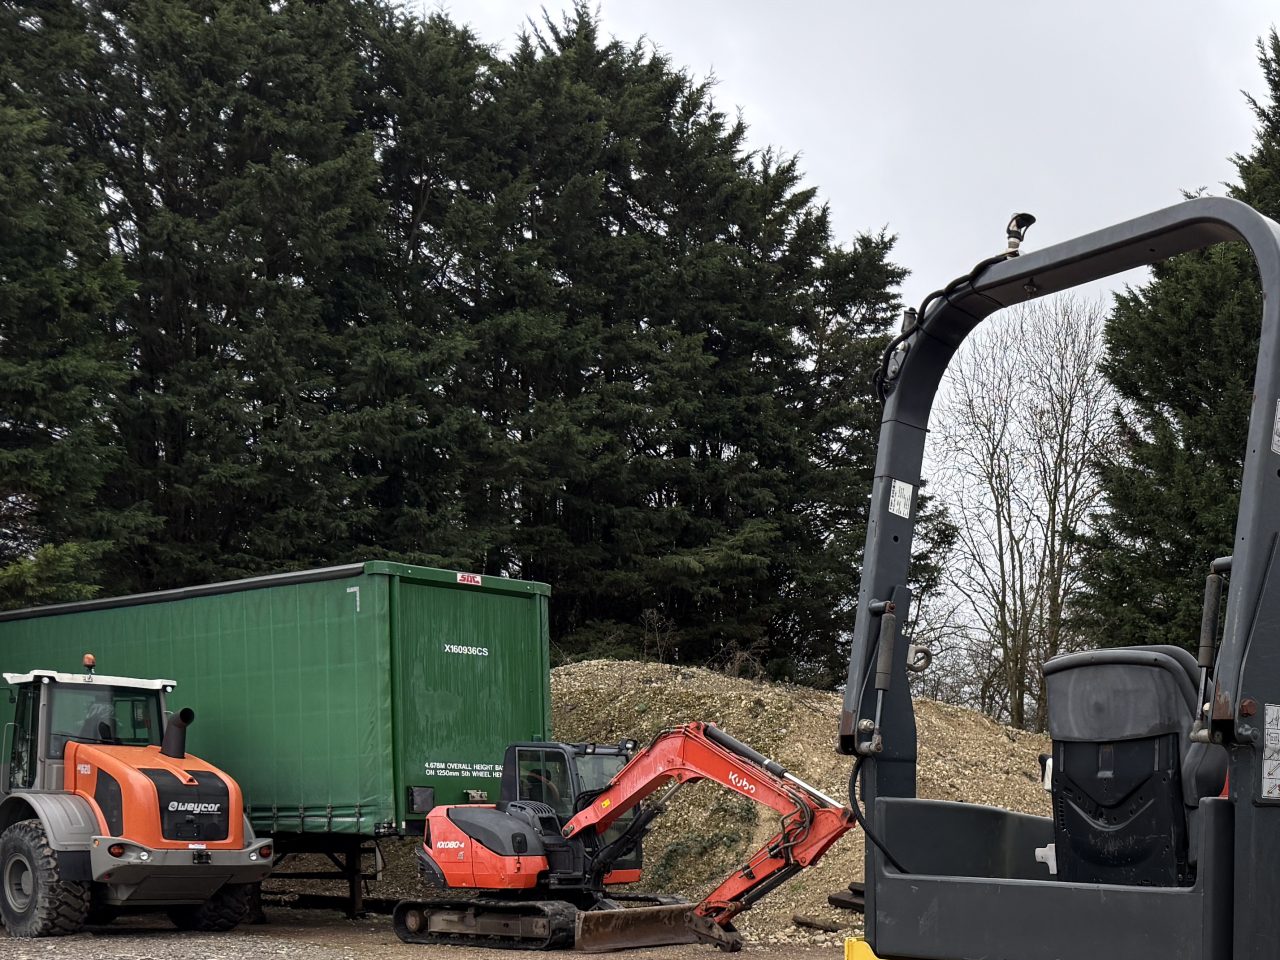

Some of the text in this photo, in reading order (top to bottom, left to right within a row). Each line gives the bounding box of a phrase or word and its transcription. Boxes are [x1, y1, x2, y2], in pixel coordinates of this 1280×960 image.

[444, 644, 489, 656] X160936CS
[436, 769, 460, 777] 1250mm
[177, 802, 221, 814] weycor
